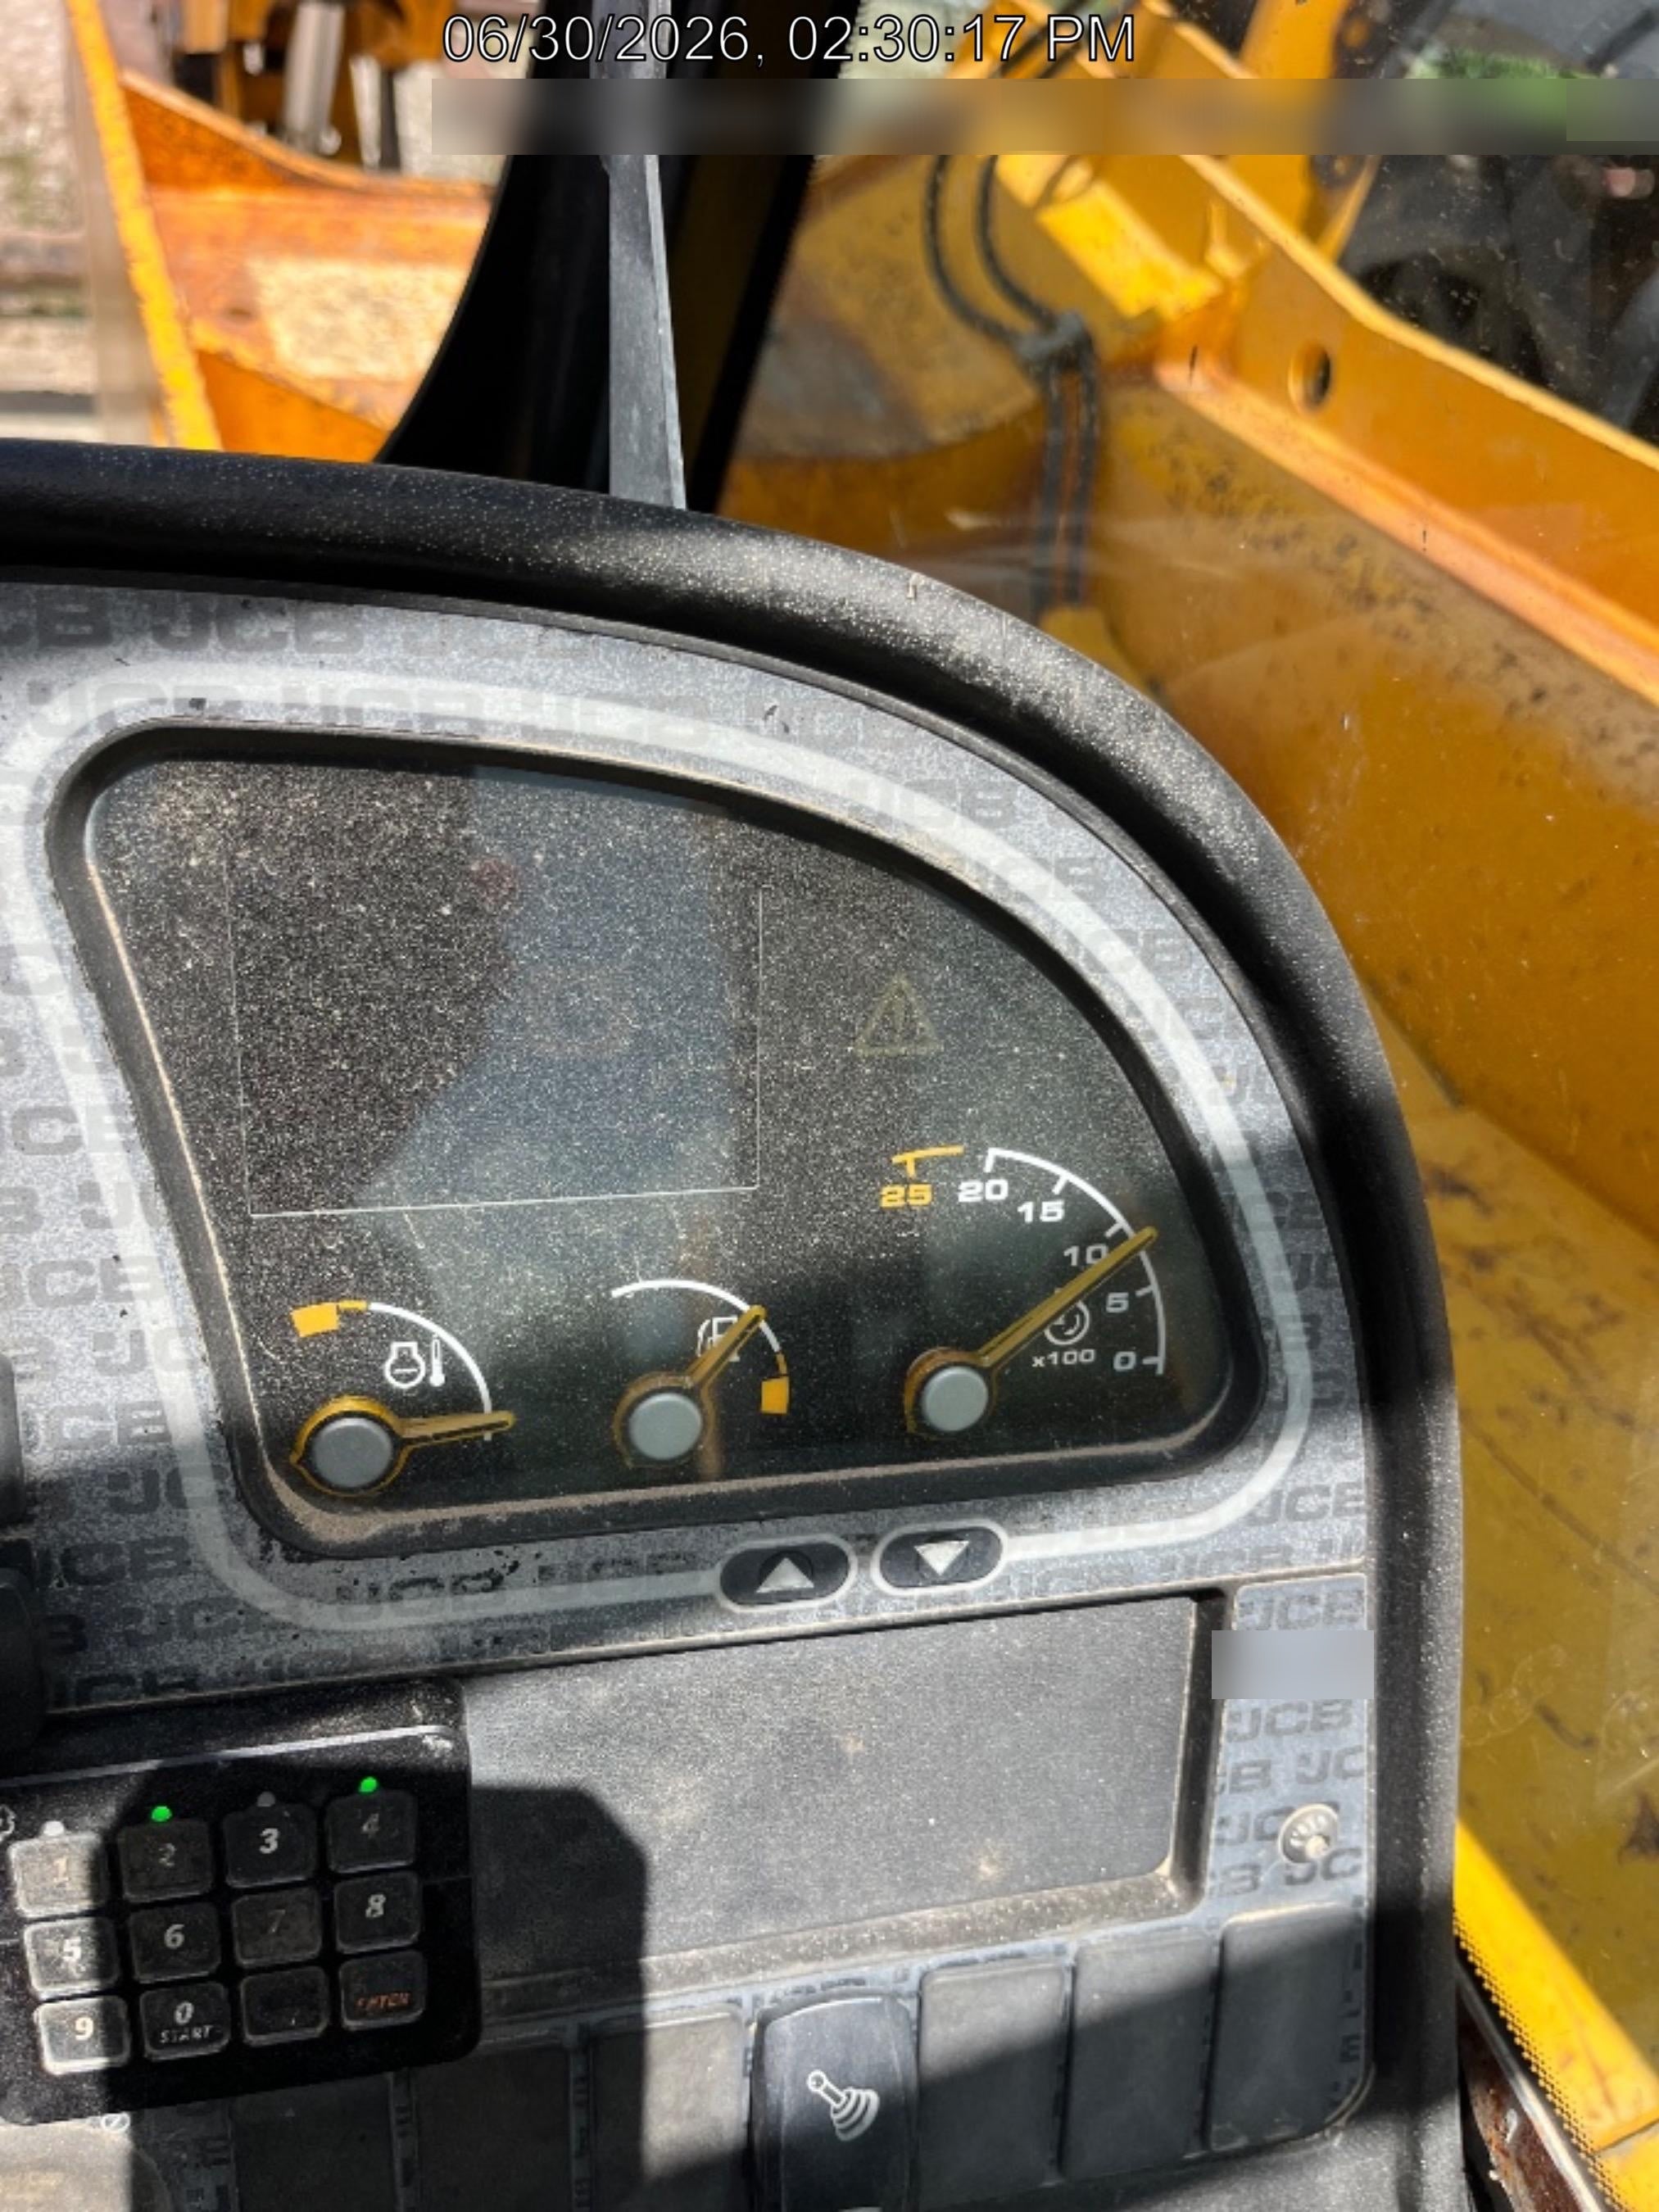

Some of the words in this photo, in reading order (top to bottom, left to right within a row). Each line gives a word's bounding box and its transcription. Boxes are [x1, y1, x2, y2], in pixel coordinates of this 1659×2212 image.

[880, 1183, 933, 1209] 25
[958, 1179, 1009, 1203] 20
[1016, 1200, 1065, 1224] 15
[1063, 1244, 1109, 1267] 10
[1105, 1292, 1131, 1314] 5
[1031, 1348, 1096, 1368] x100
[1113, 1350, 1137, 1371] 0
[360, 1812, 380, 1838] 4
[259, 1828, 280, 1855] 3
[159, 1843, 177, 1868] 2
[53, 1857, 70, 1883] 1
[365, 1893, 387, 1919] 8
[62, 1937, 83, 1962] 5
[164, 1924, 186, 1951] 6
[174, 2001, 195, 2026] 0
[74, 2016, 95, 2041] 9
